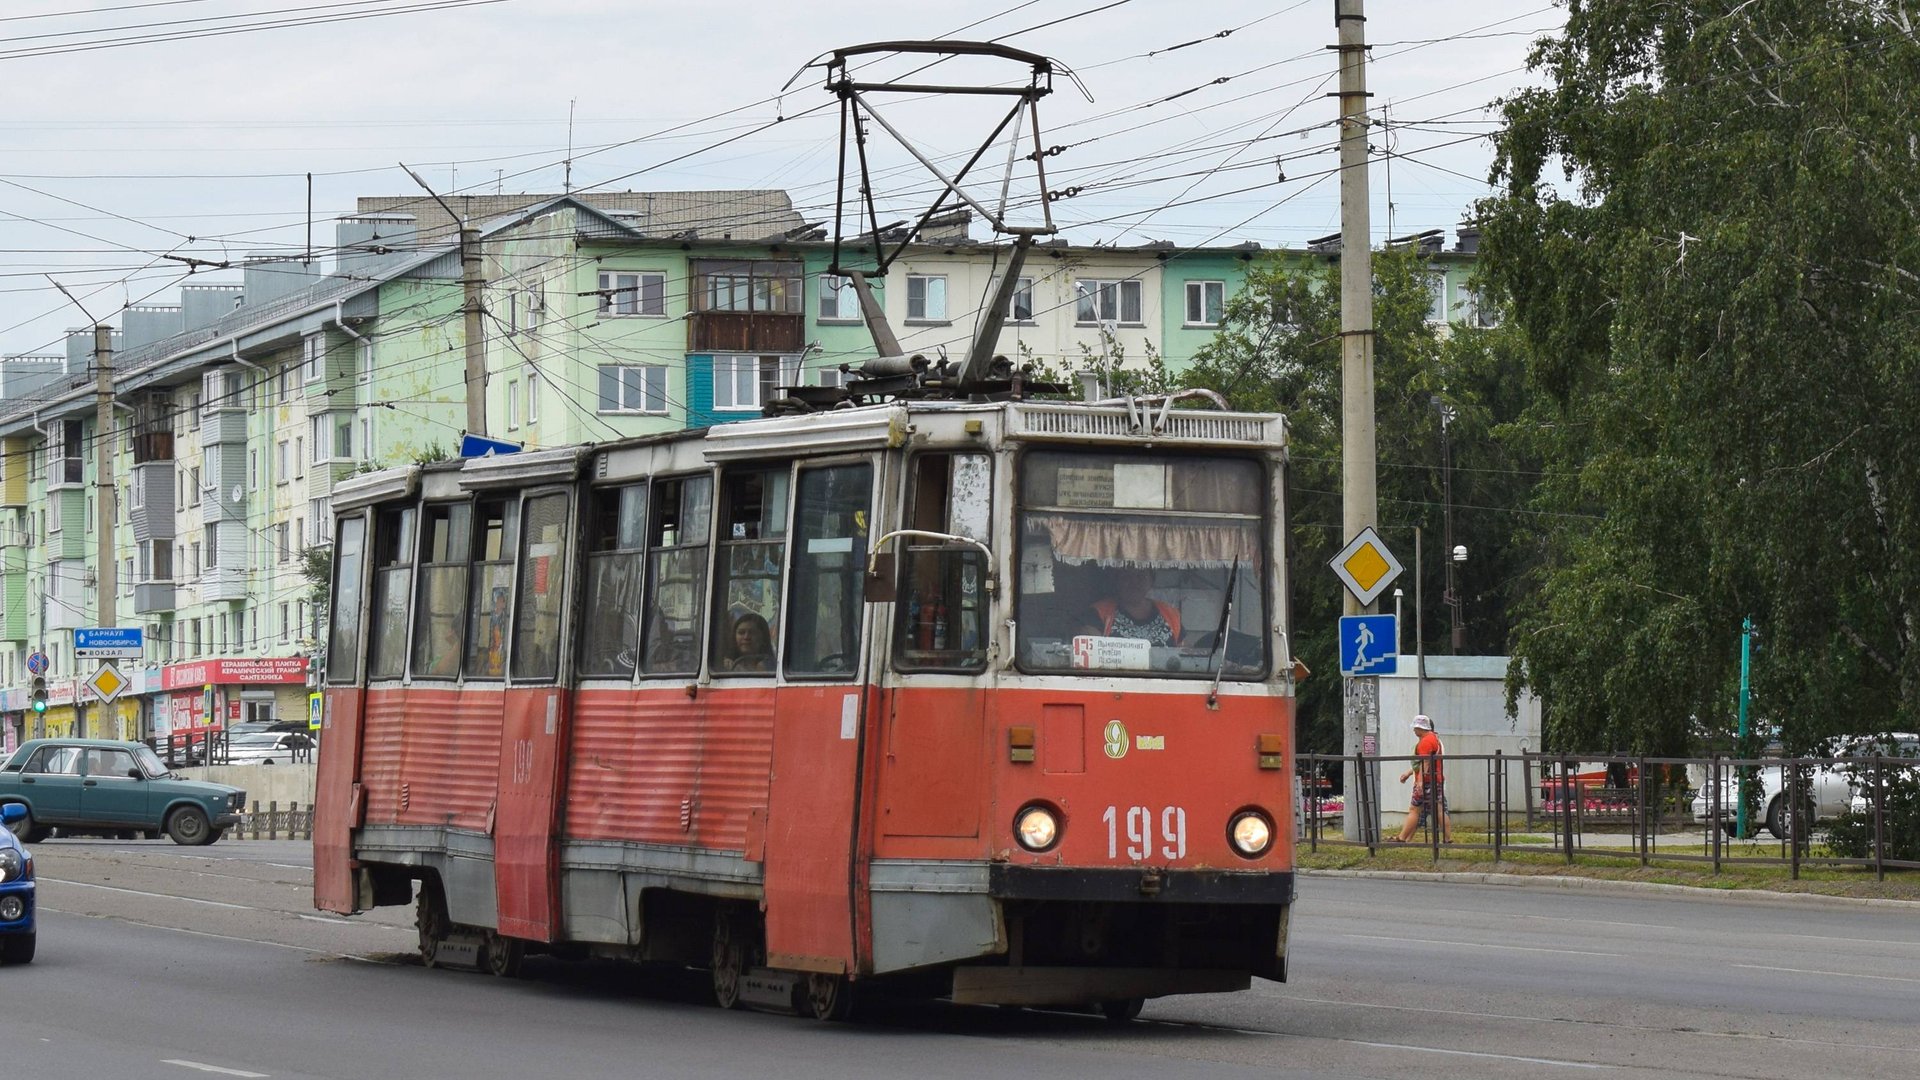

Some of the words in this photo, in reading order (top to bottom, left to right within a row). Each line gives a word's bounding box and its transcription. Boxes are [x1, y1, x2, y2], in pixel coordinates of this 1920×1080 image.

[221, 667, 275, 675] КЕРАМИЧЕСКИЙ
[275, 660, 302, 668] ПЛИТКА
[1104, 719, 1130, 759] 9
[513, 739, 533, 784] 199
[1102, 805, 1186, 861] 199
